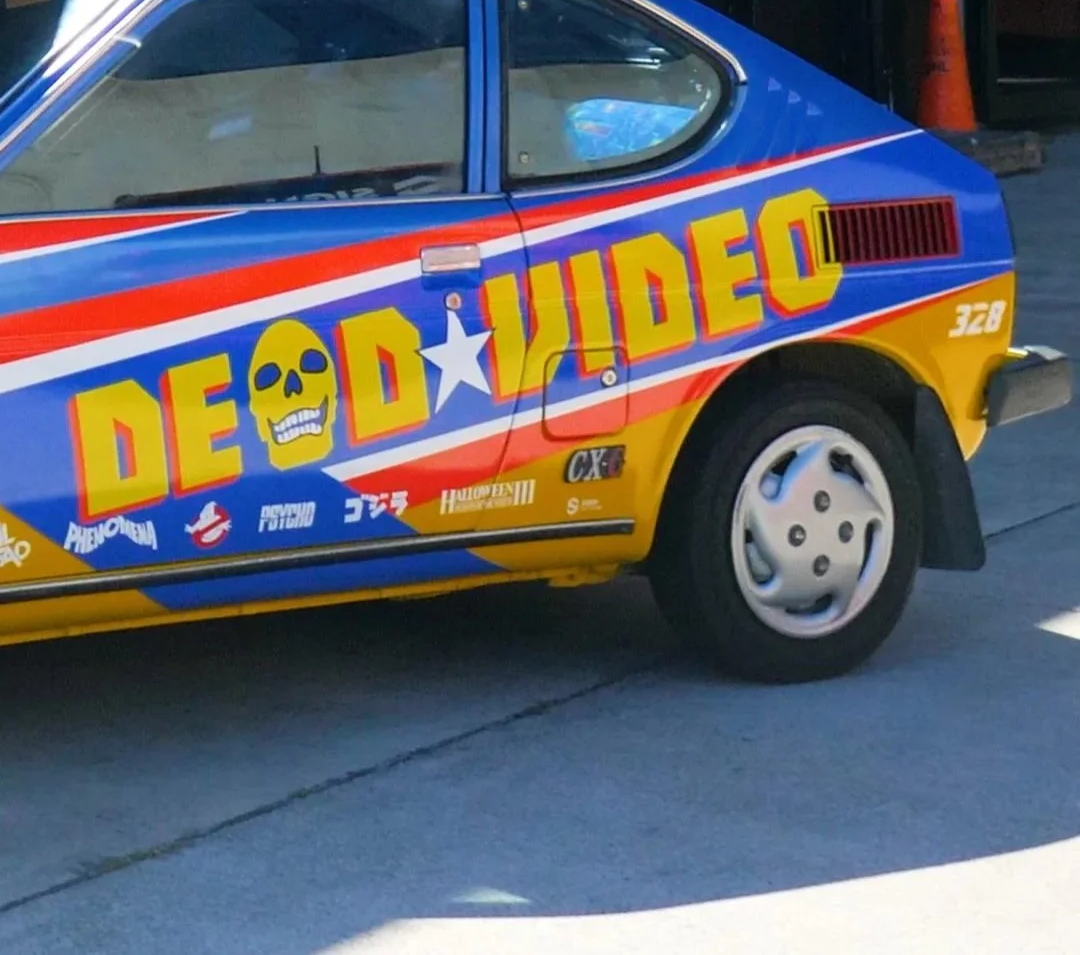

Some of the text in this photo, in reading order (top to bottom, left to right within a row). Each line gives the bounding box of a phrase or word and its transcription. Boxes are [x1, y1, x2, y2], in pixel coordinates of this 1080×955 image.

[482, 189, 844, 405] VIDEO
[948, 300, 1008, 339] 328
[258, 501, 316, 533] PSYCHO
[344, 490, 408, 523] ゴジラ
[64, 515, 157, 554] PHENOMENA
